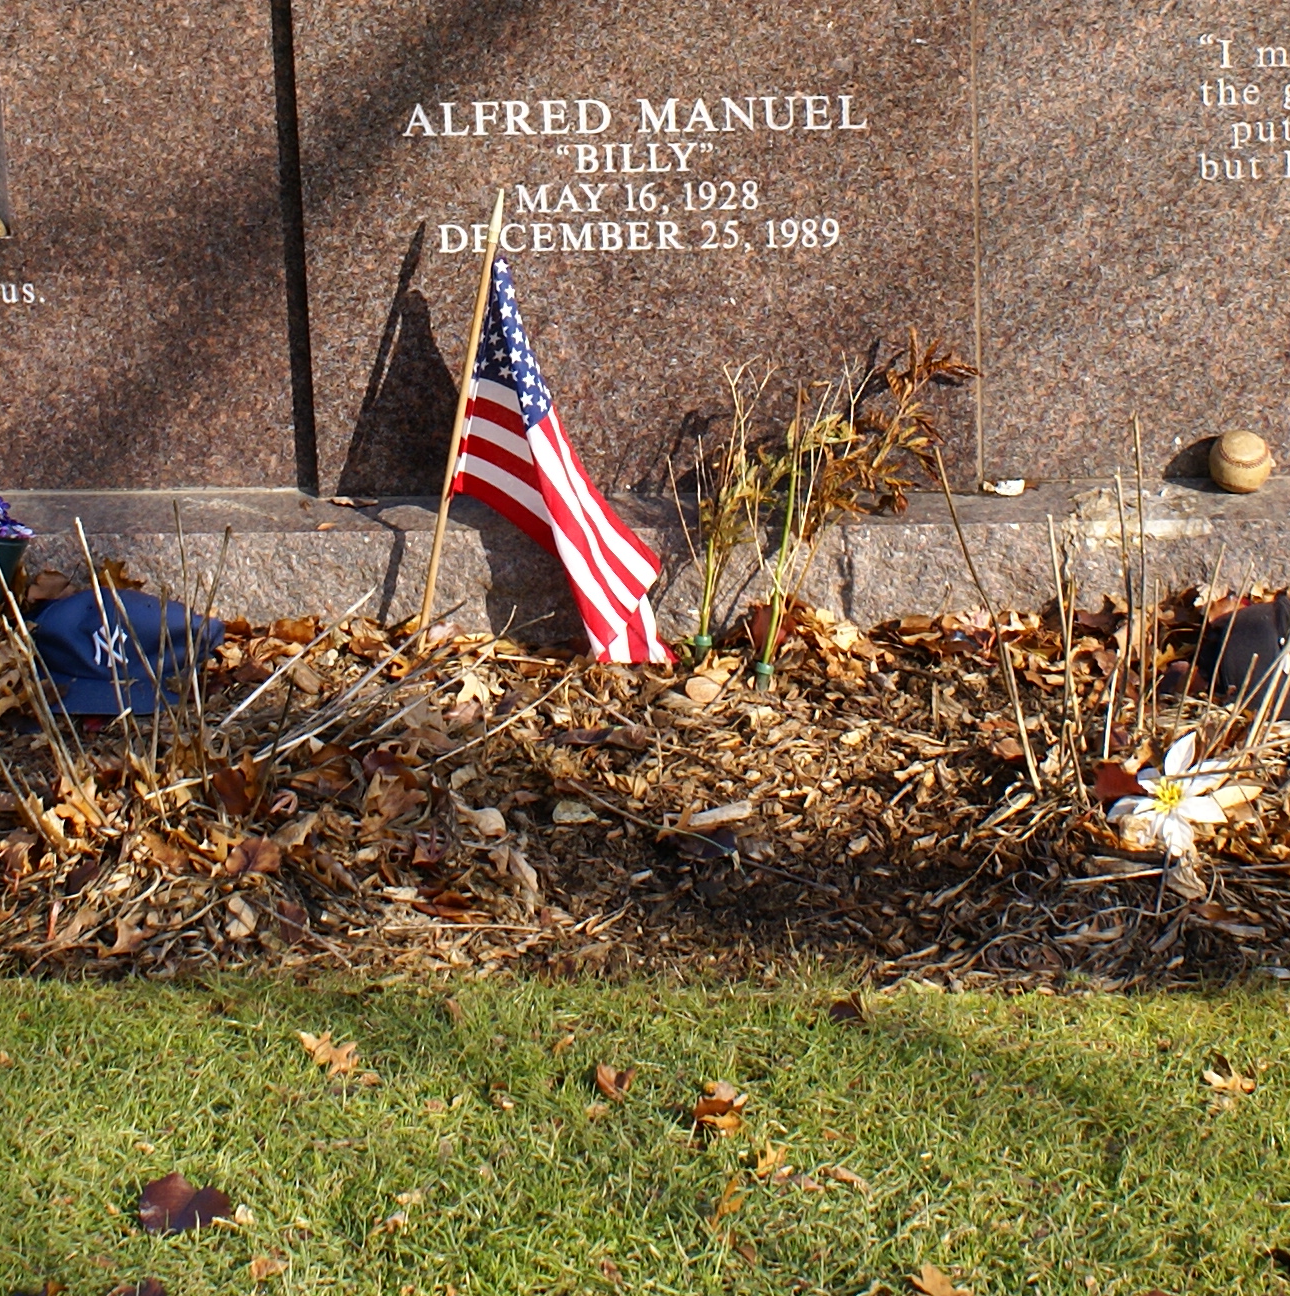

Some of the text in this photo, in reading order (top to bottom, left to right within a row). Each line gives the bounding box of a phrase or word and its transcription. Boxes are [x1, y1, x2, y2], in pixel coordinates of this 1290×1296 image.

[1200, 78, 1260, 106] the
[402, 95, 868, 137] ALFRED MANUEL
[556, 142, 715, 175] “BILLY”
[1199, 153, 1262, 181] but
[515, 180, 759, 217] MAY 16, 1928
[702, 218, 752, 253] 25,
[764, 218, 841, 250] 1989
[0, 280, 47, 304] us.
